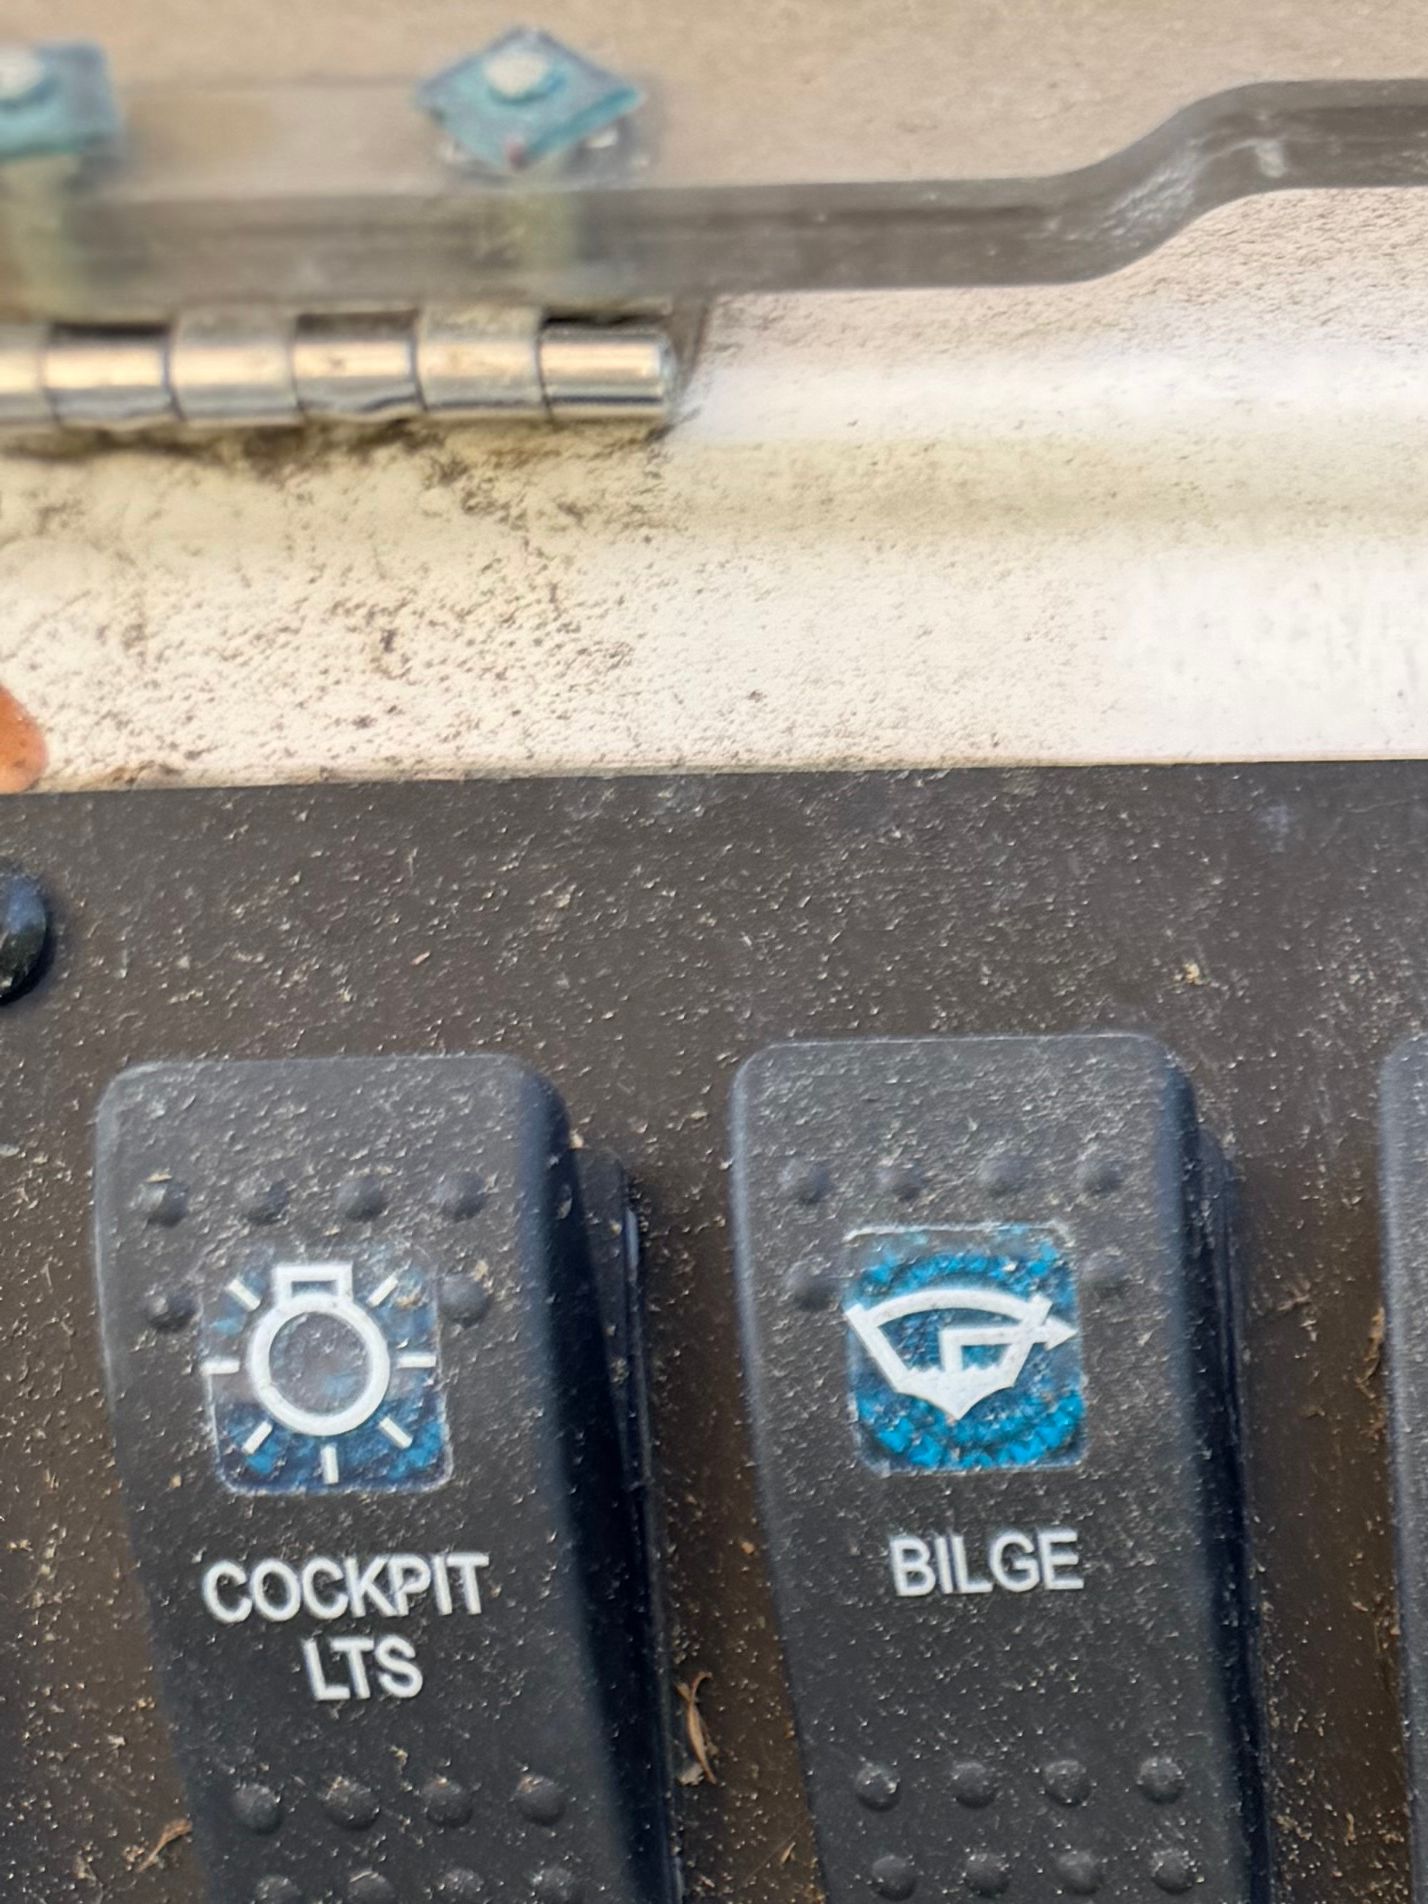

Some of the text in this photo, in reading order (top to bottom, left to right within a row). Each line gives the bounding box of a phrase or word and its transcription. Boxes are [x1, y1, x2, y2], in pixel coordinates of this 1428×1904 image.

[201, 1553, 489, 1623] COCKPIT
[888, 1528, 1084, 1598] BILGE
[302, 1636, 424, 1704] LTS
